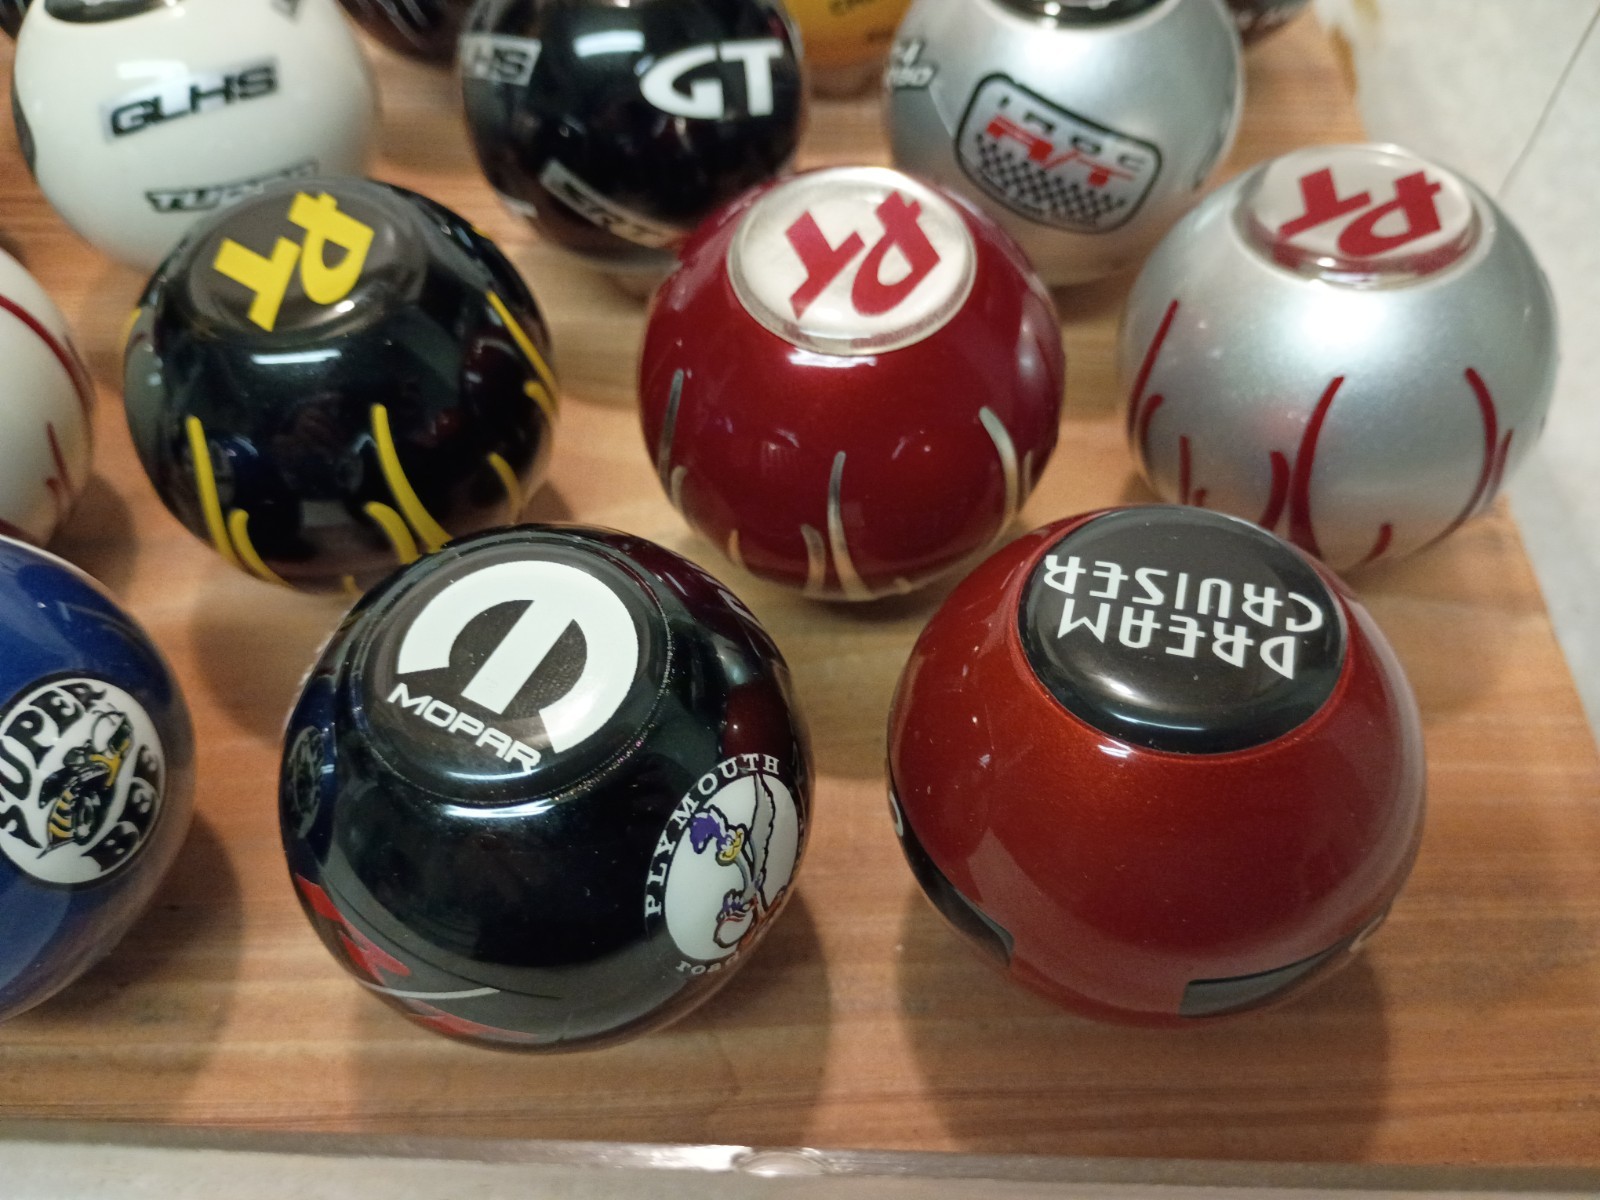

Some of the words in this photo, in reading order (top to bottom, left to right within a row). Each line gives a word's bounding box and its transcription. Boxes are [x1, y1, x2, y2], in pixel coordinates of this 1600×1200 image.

[110, 64, 278, 136] GLHS
[639, 38, 784, 120] GT
[1043, 554, 1324, 633] CRUISER
[1057, 597, 1296, 681] DREAM
[388, 682, 542, 775] MOPAR
[645, 753, 780, 918] PLYMOUTH
